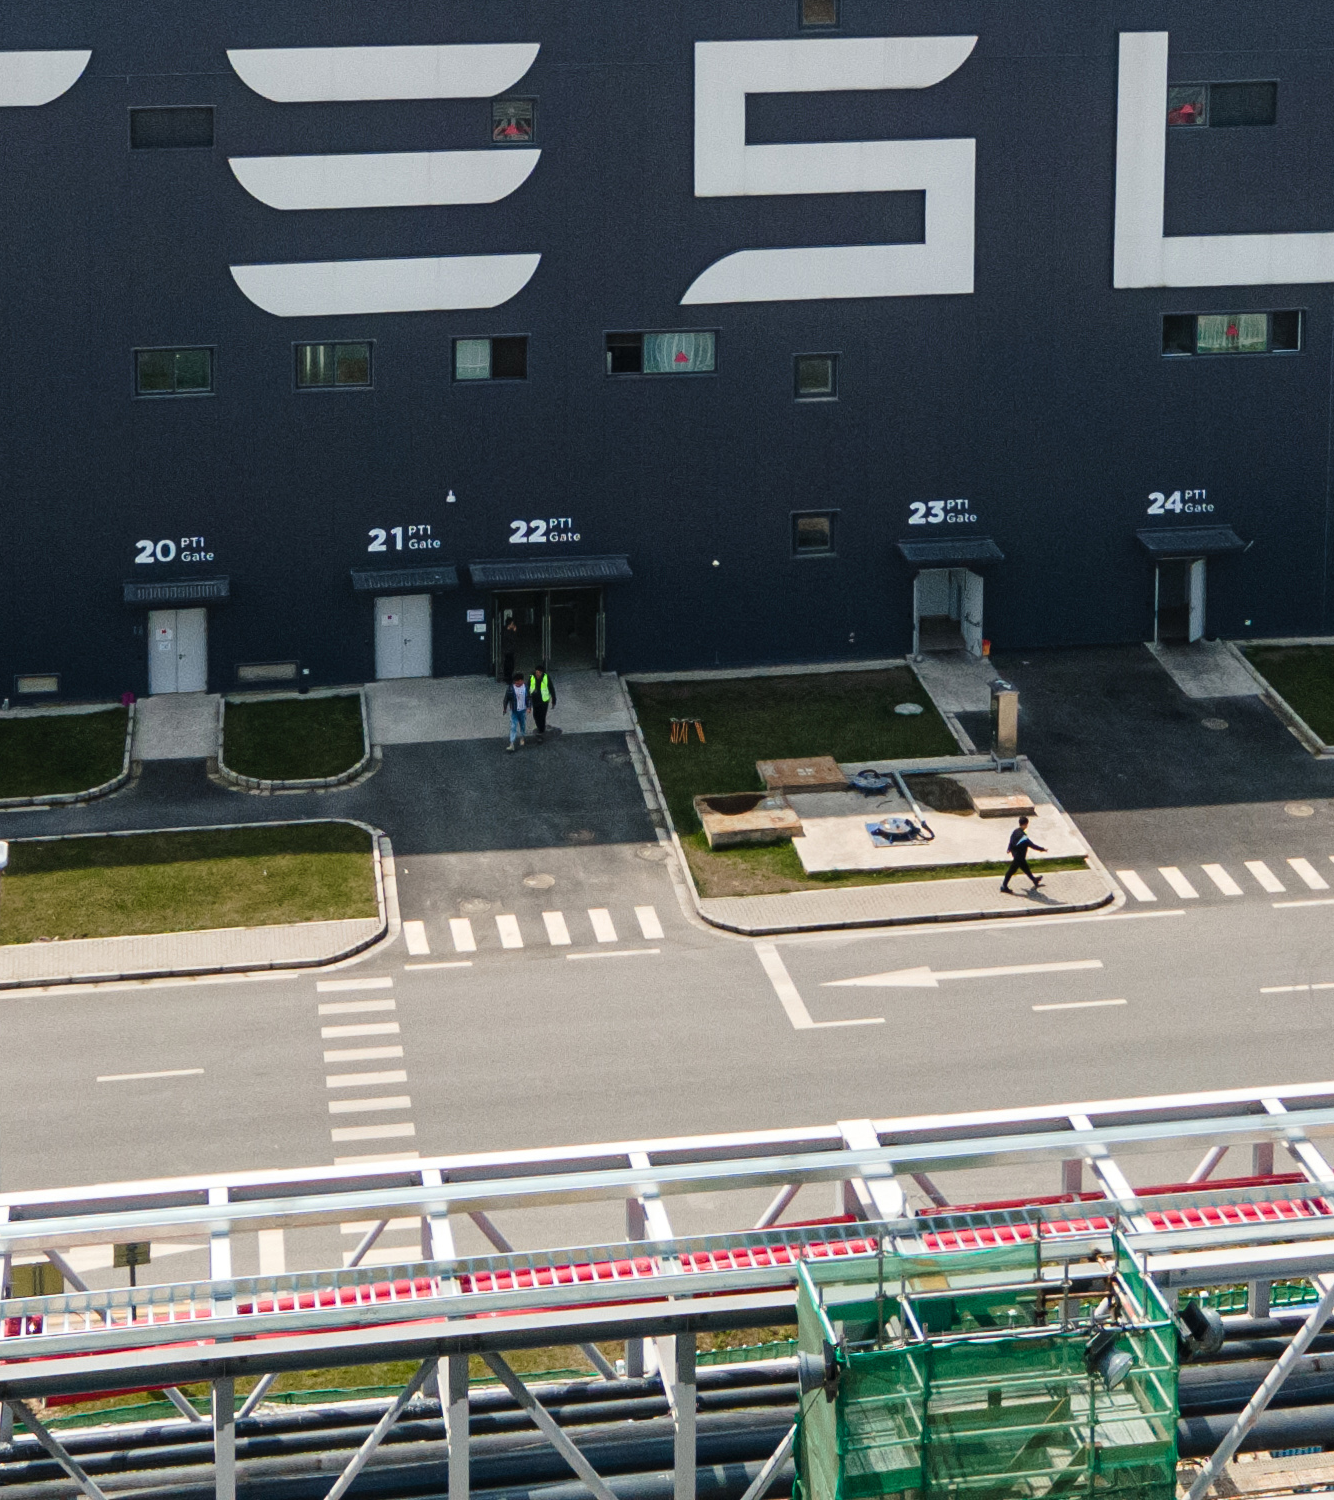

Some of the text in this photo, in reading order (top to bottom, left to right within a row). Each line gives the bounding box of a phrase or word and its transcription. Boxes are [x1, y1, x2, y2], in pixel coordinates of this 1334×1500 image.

[1185, 489, 1205, 500] PT1
[947, 499, 968, 510] PT1
[1147, 491, 1183, 514] 24
[1185, 503, 1214, 512] Gate
[908, 501, 944, 524] 23
[947, 513, 977, 523] Gate
[550, 518, 571, 528] PT1
[409, 525, 430, 536] PT1
[509, 520, 546, 543] 22
[181, 537, 204, 548] PT1
[368, 527, 402, 551] 21
[549, 532, 580, 542] Gate
[409, 539, 440, 549] Gate
[135, 540, 176, 563] 20
[181, 551, 214, 561] Gate
